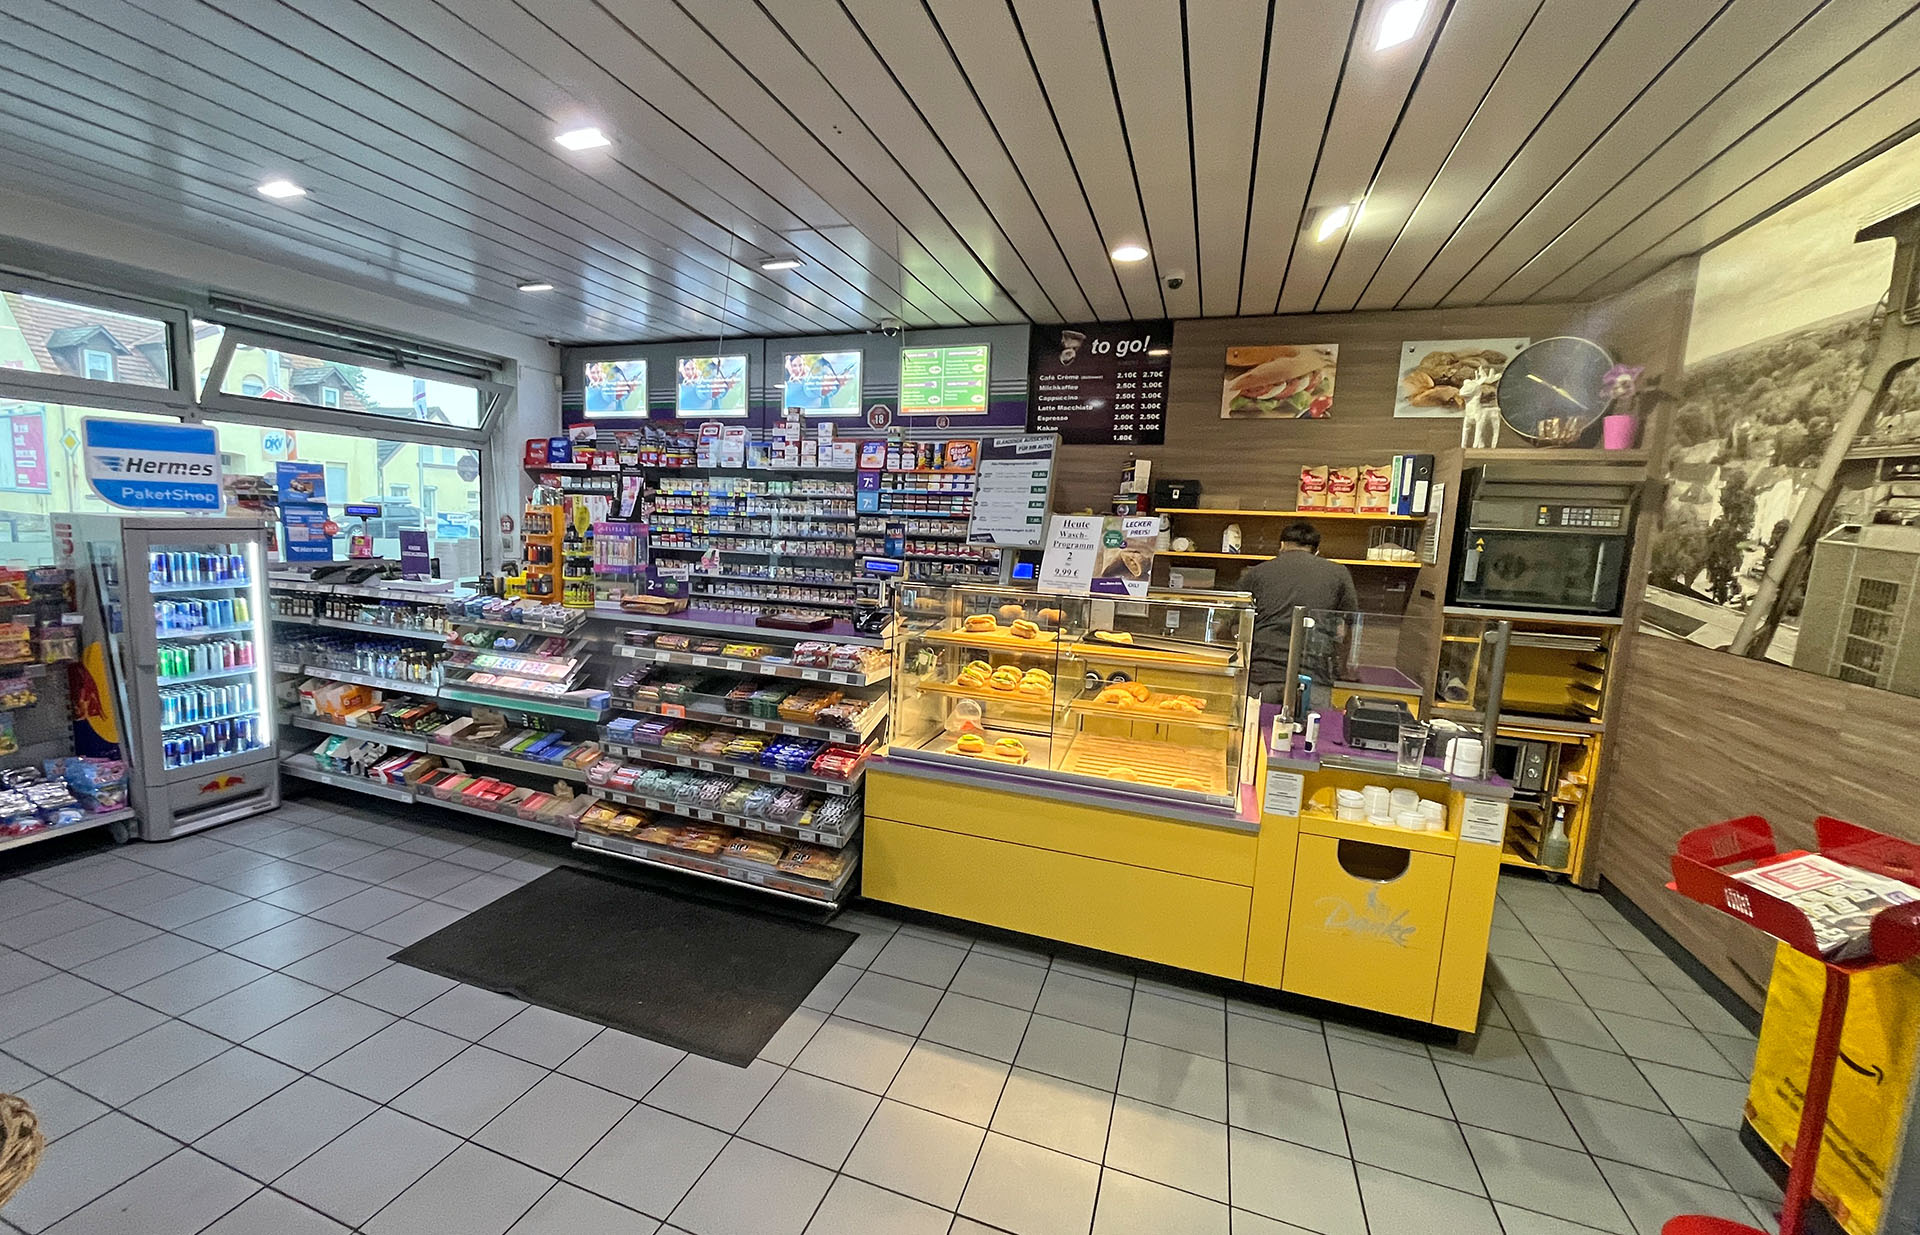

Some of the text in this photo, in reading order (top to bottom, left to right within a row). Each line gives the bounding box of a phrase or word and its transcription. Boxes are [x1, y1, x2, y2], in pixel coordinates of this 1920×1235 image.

[1091, 335, 1151, 358] to go!
[1117, 371, 1137, 379] 2.10€
[265, 438, 283, 450] DKV
[125, 457, 213, 476] Hermes
[121, 487, 215, 504] PaketShop
[1063, 519, 1090, 529] Heute
[1125, 520, 1153, 528] LECKER
[1059, 530, 1088, 539] Wasch-
[1129, 528, 1151, 536] PREIS!
[1053, 540, 1095, 550] Programm
[1067, 551, 1073, 561] 2
[1054, 568, 1079, 577] 9,99 €
[647, 579, 655, 590] 2
[1315, 896, 1416, 948] Danke
